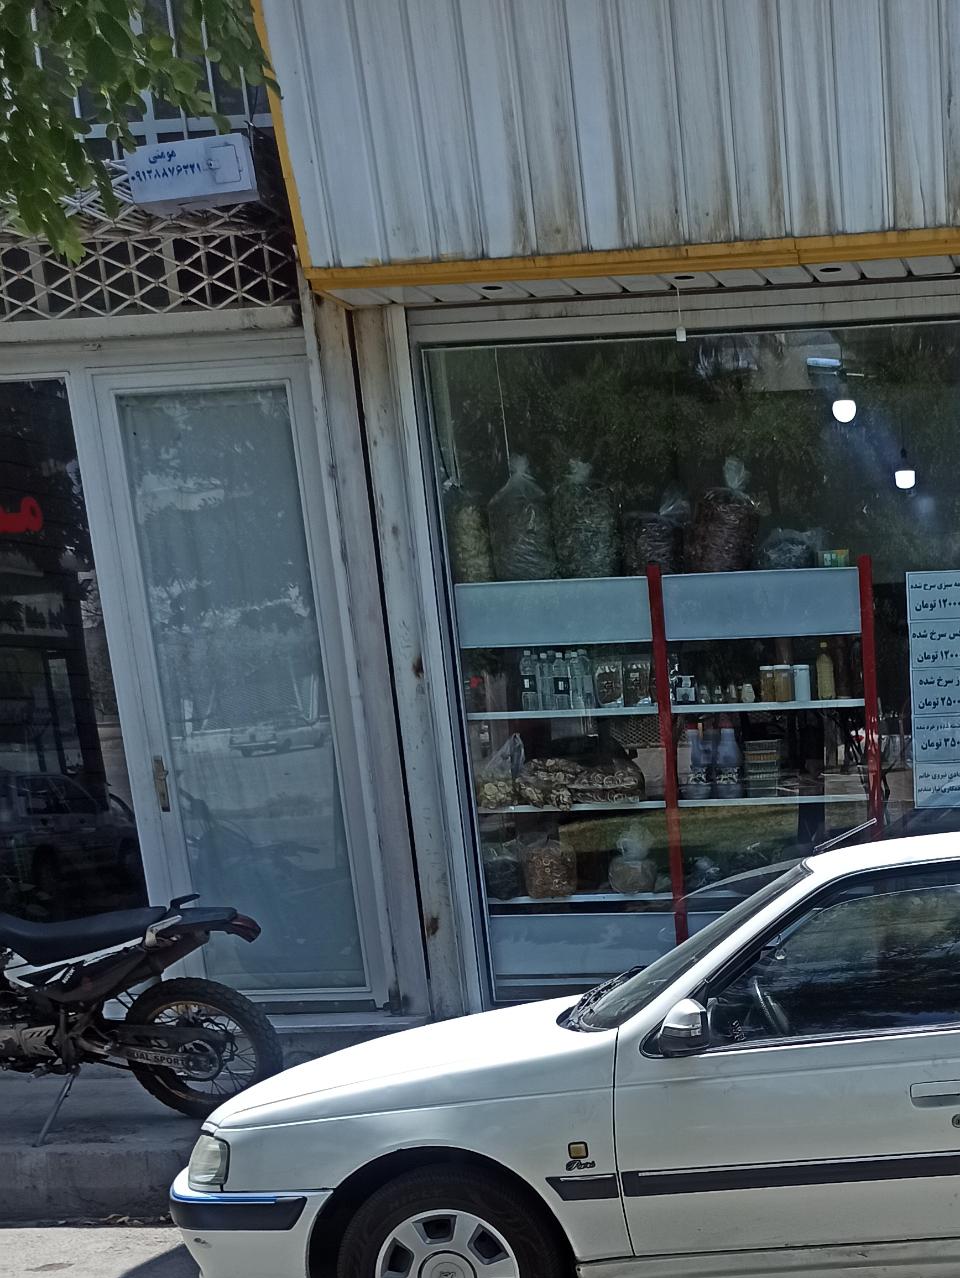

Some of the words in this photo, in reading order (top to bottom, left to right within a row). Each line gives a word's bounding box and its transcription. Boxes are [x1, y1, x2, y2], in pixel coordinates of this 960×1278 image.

[914, 599, 937, 613] تومان
[911, 629, 928, 639] شده
[929, 628, 947, 641] سرخ
[916, 650, 939, 663] تومان
[918, 676, 935, 686] شده
[936, 676, 954, 688] سرخ
[918, 696, 940, 710] تومان
[920, 738, 942, 751] تومان
